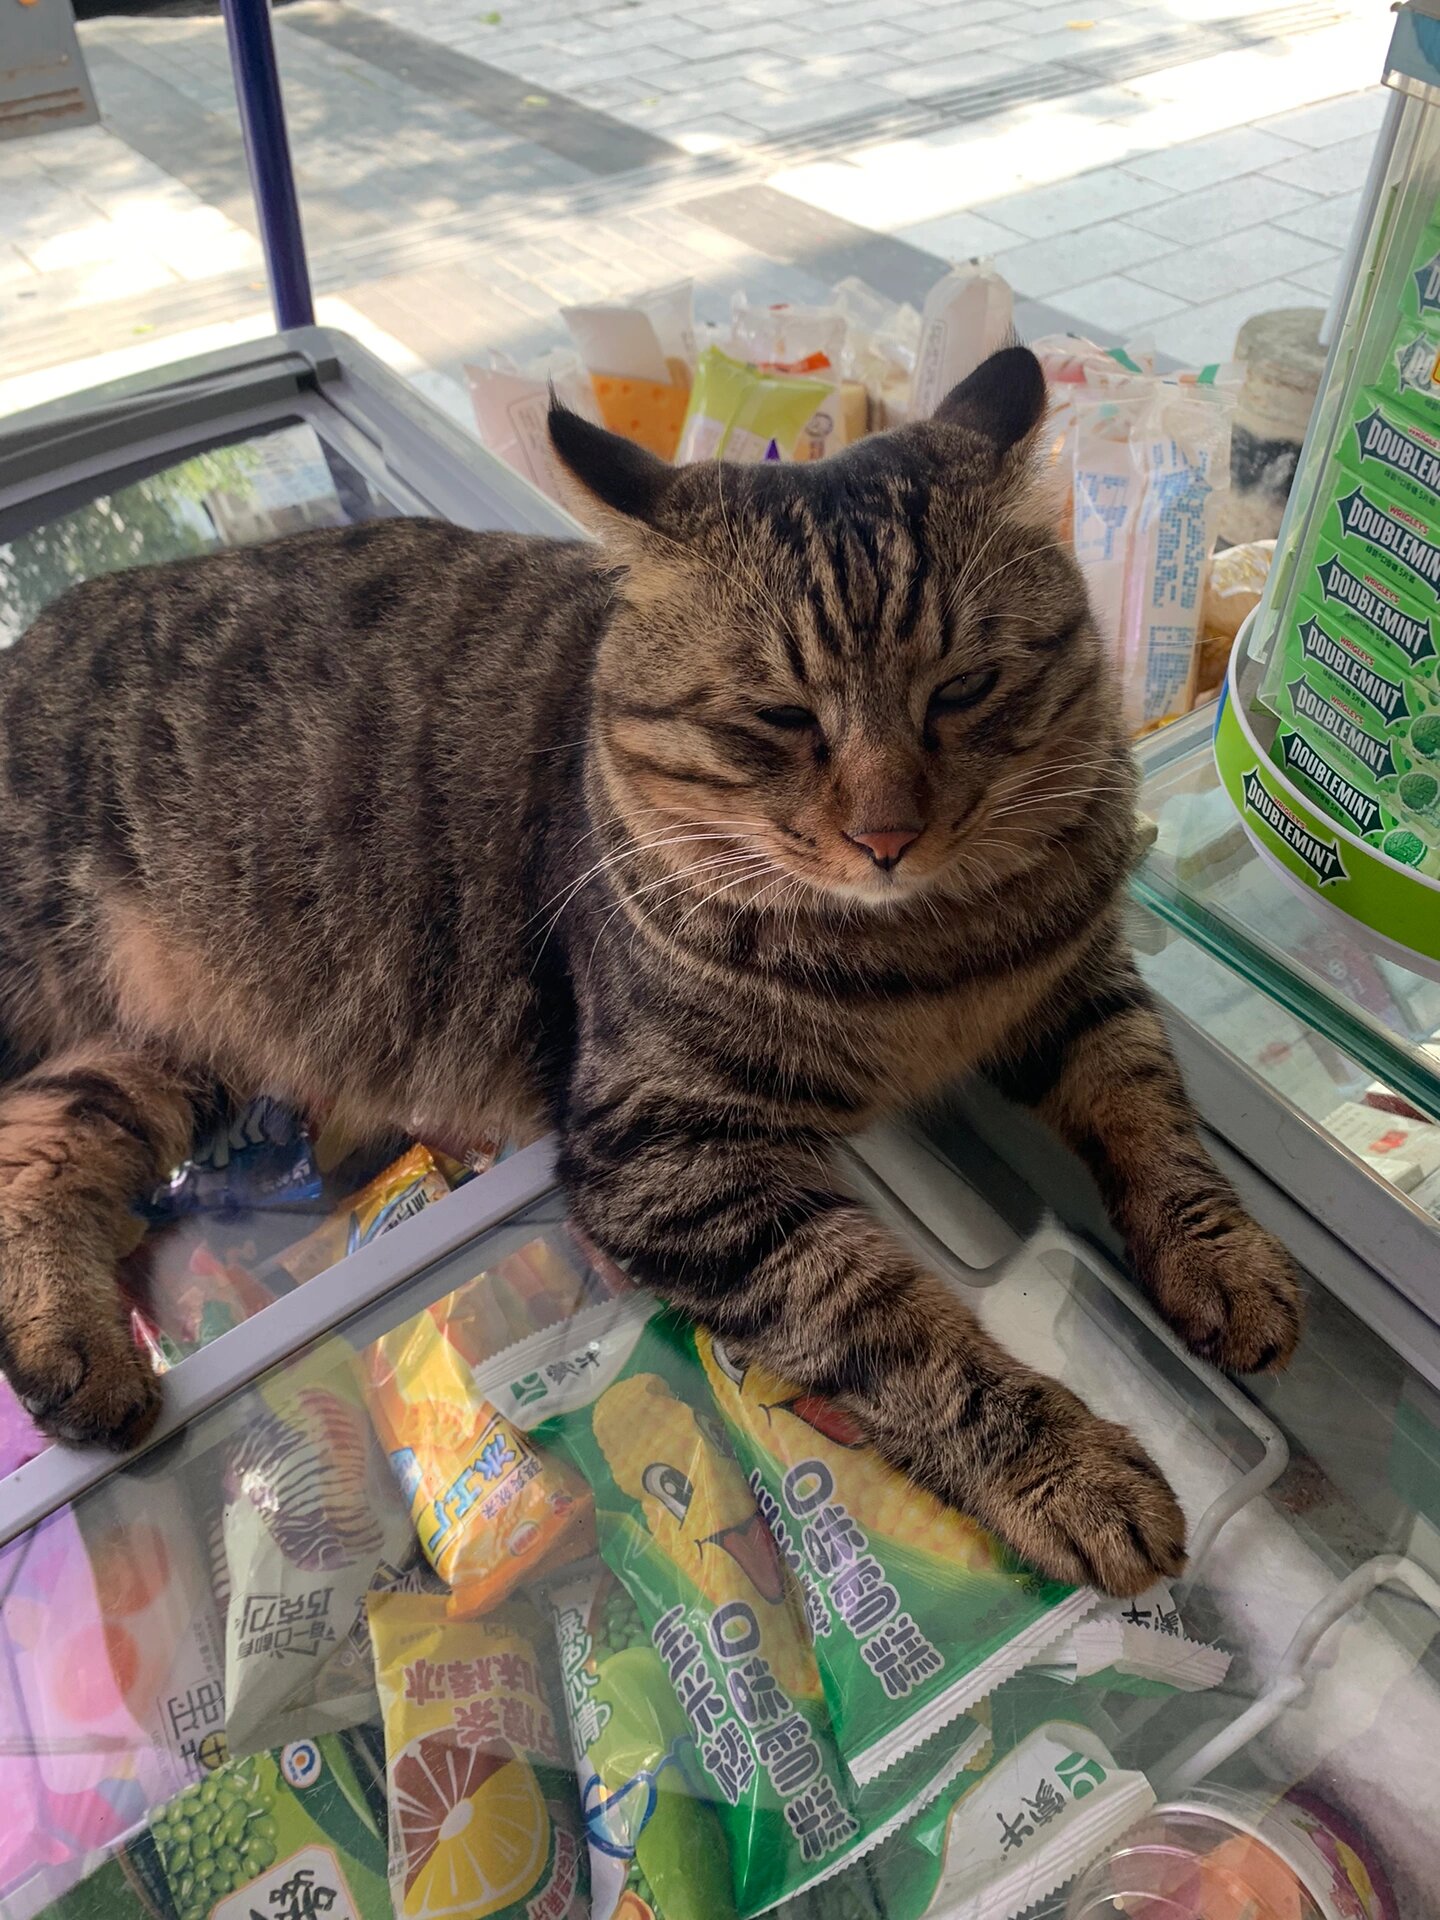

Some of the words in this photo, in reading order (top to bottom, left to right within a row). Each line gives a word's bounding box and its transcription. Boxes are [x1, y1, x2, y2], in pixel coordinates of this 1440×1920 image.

[1327, 564, 1428, 655] DOUBLEMINT
[1306, 625, 1402, 716] DOUBLEMINT
[1296, 684, 1389, 772] DOUBLEMINT
[1247, 779, 1336, 874] DOUBLEMINT
[1288, 736, 1377, 828] DOUBLEMINT
[428, 1433, 516, 1549] 冰工厂
[782, 1457, 945, 1700] 口味雪糕
[237, 1620, 327, 1659] 每一口都有
[404, 1652, 541, 1706] 味棒冰
[709, 1600, 860, 1863] 口味雪糕
[996, 1778, 1067, 1856] 蒙牛
